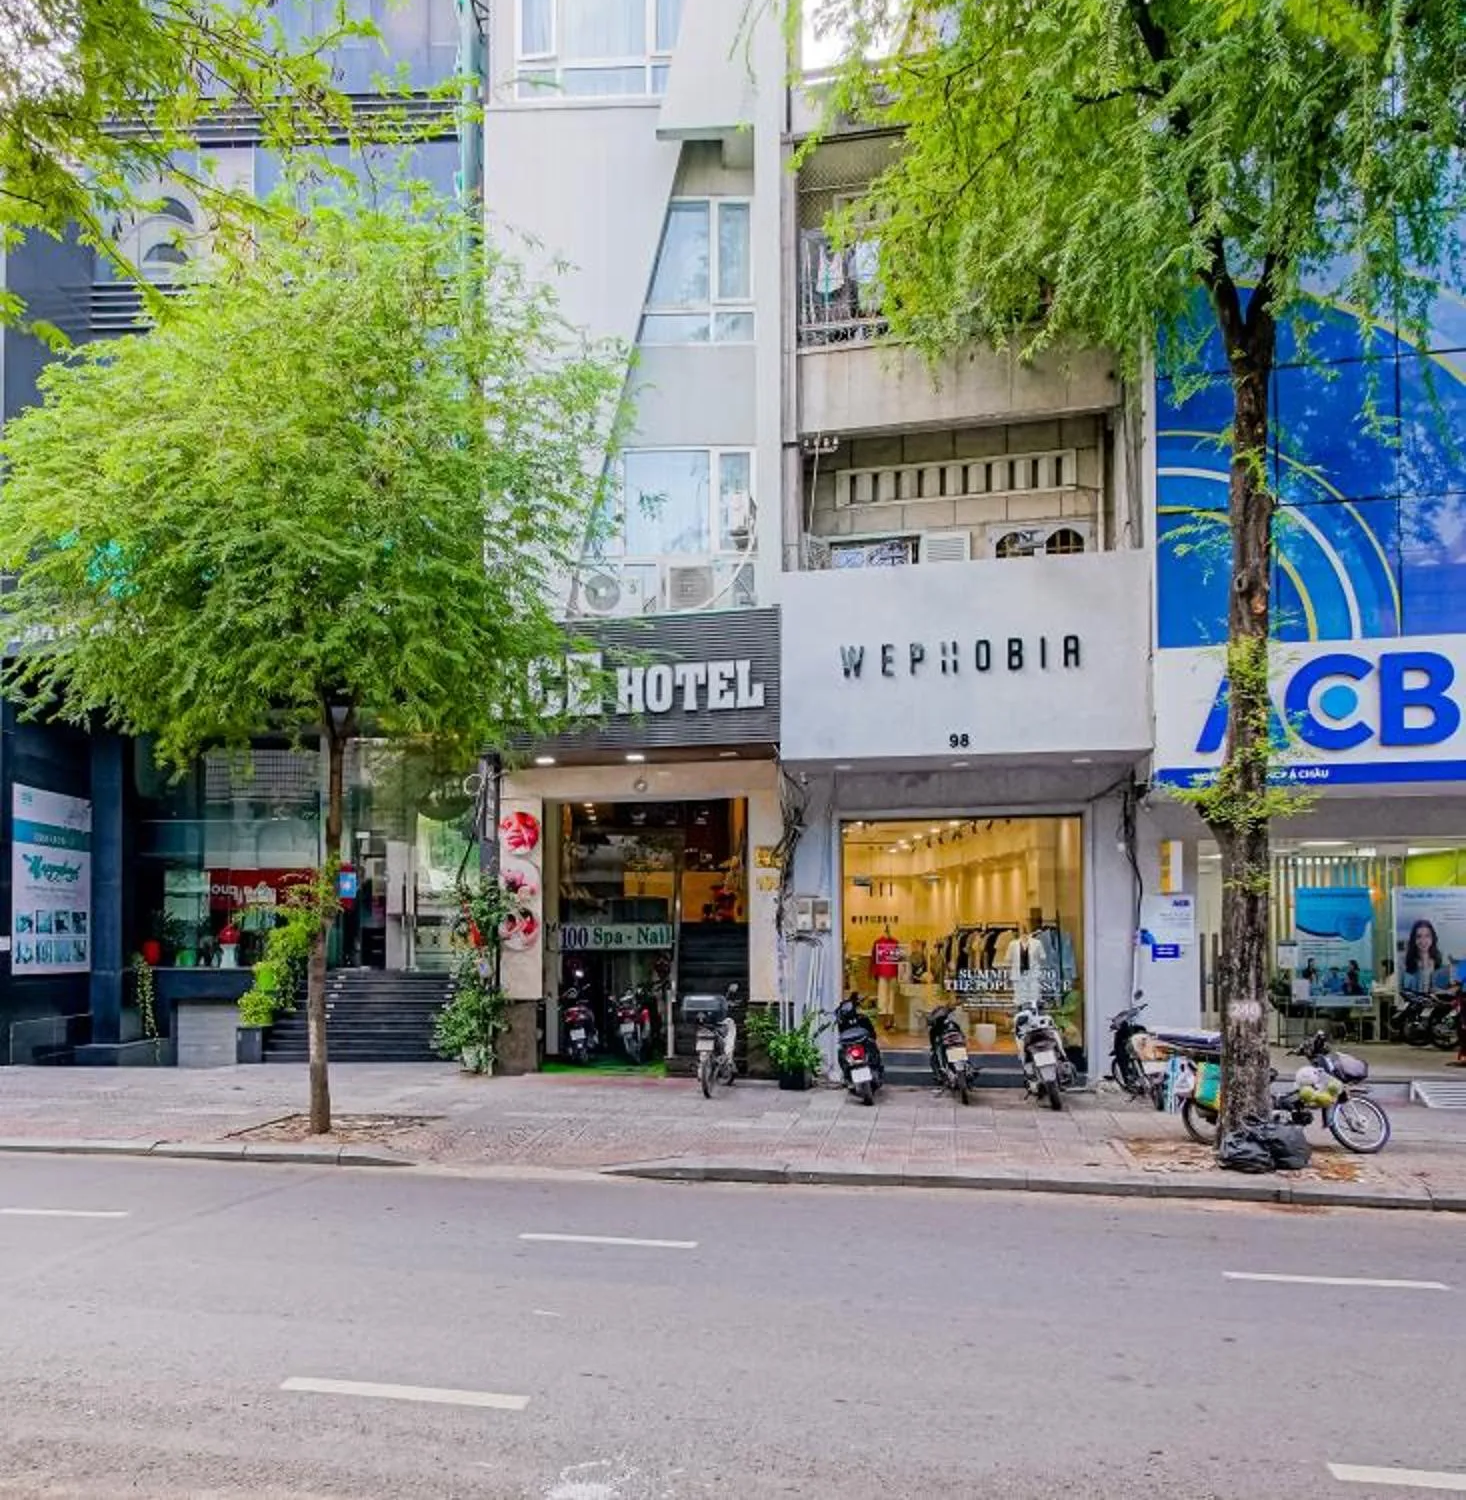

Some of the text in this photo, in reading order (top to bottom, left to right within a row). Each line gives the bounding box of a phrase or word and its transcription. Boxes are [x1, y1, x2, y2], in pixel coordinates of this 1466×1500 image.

[839, 634, 1081, 679] WEPHOBIA
[615, 658, 765, 715] HOTEL
[949, 733, 970, 748] 98
[562, 926, 589, 949] 100
[593, 927, 623, 947] Spa
[637, 926, 671, 946] Nail
